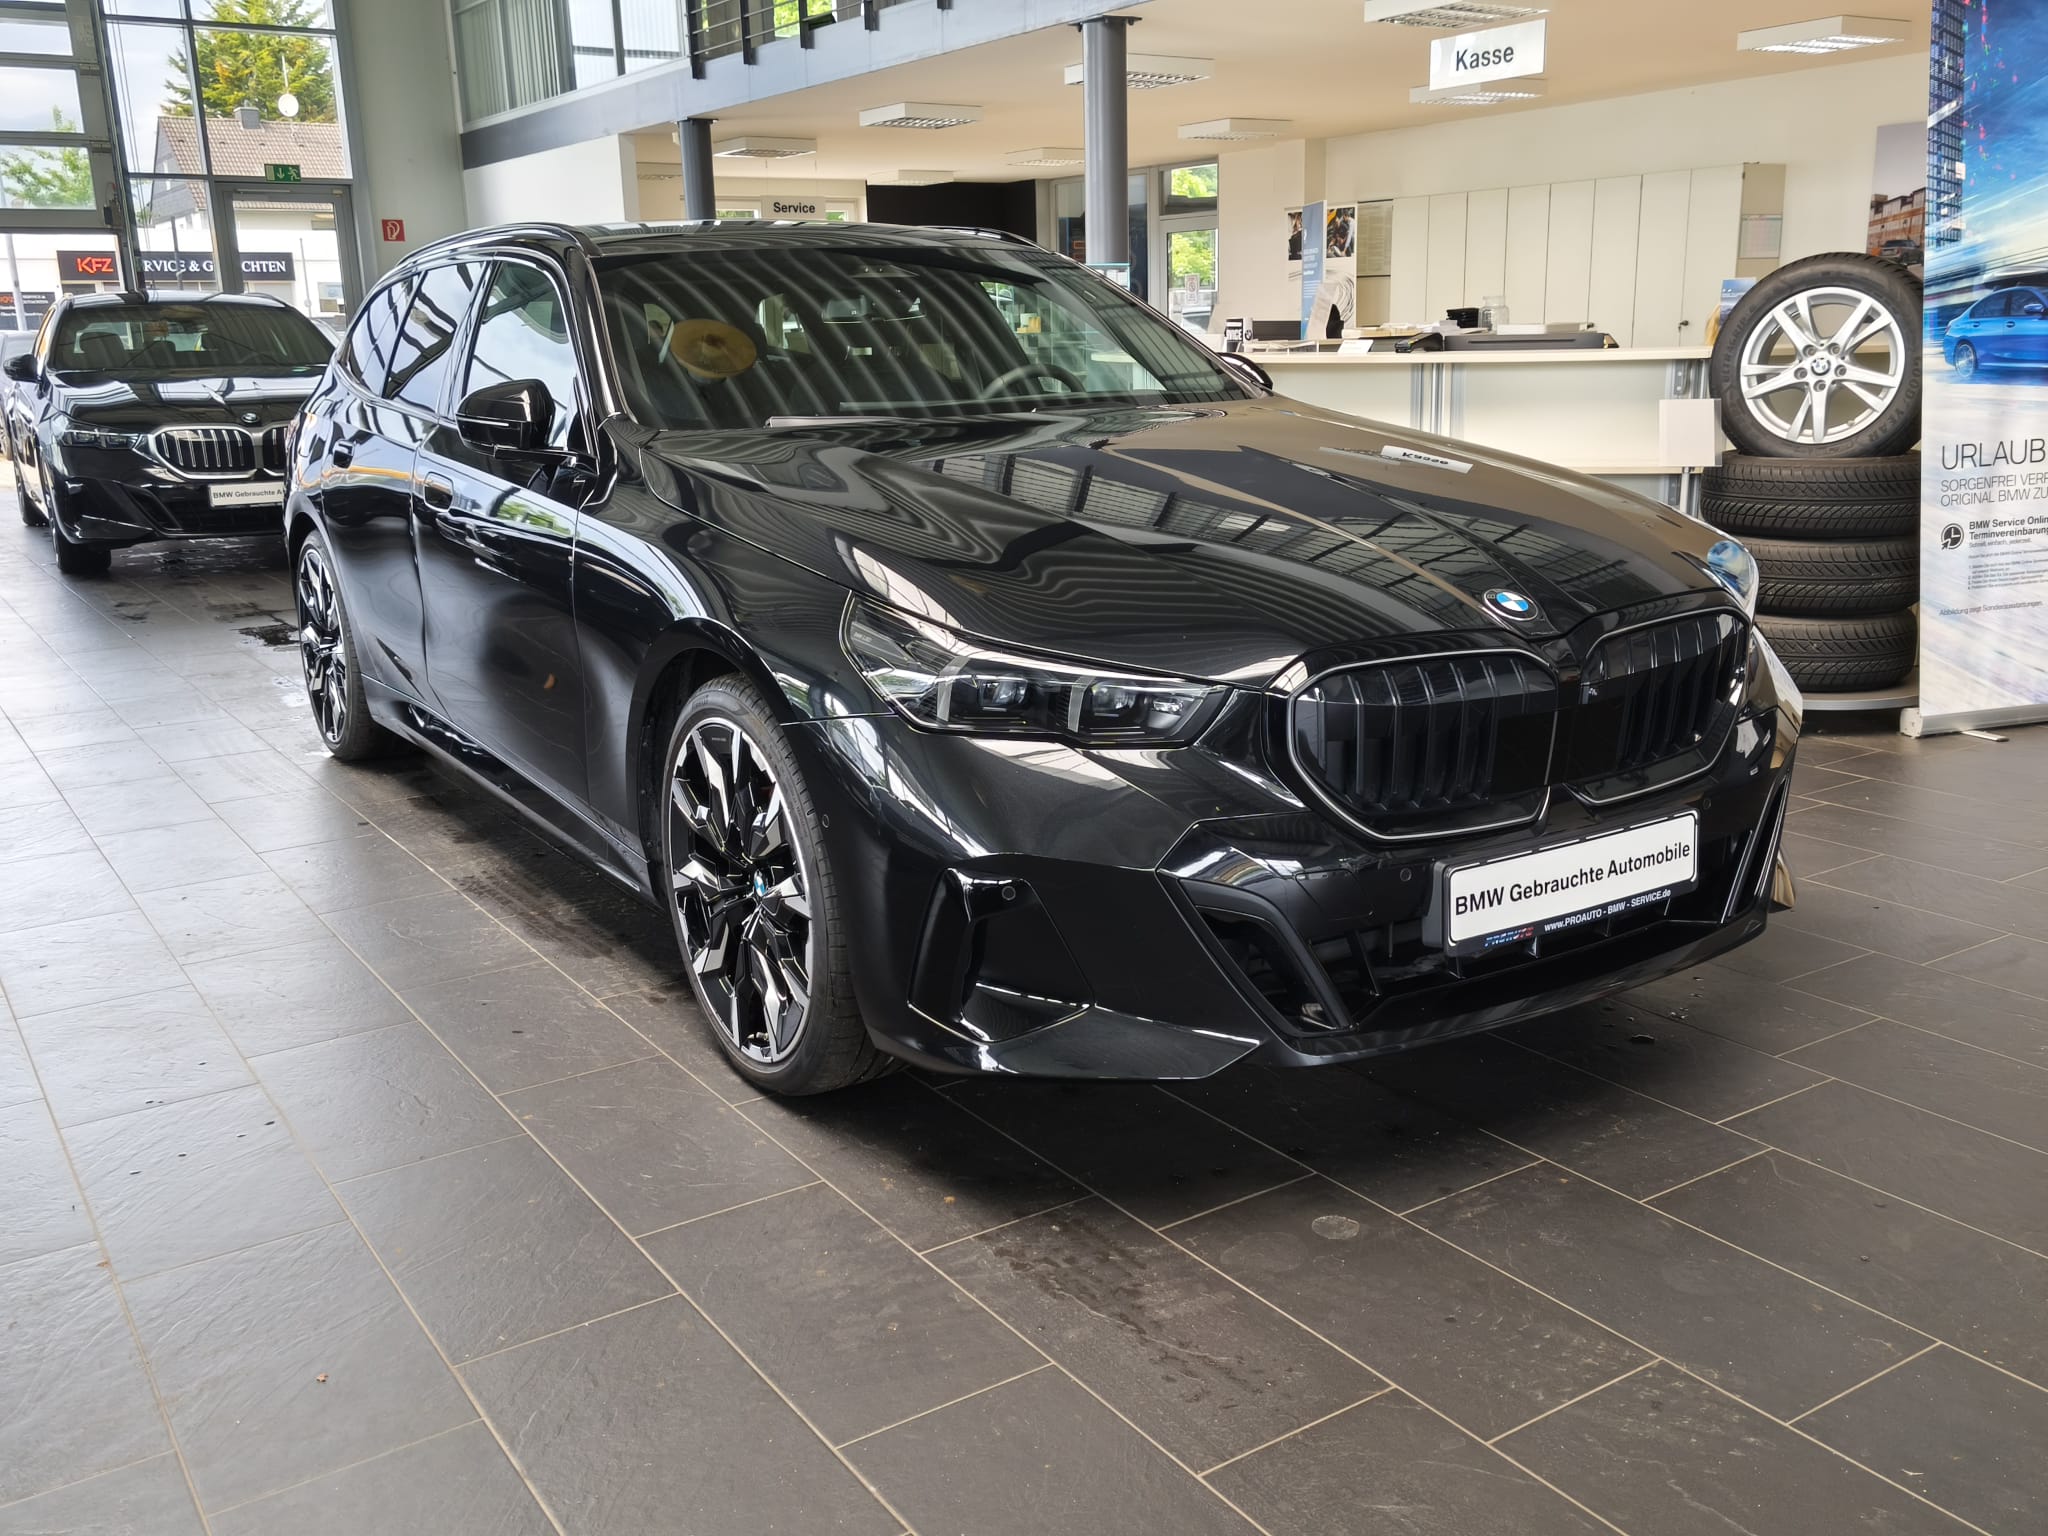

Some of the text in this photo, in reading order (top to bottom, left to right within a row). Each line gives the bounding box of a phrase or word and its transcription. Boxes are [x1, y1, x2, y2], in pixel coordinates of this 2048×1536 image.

[1456, 46, 1514, 71] Kasse
[773, 201, 816, 214] Service
[77, 256, 114, 274] KFZ
[144, 260, 186, 273] RVICE
[188, 260, 201, 273] &
[1941, 438, 2046, 471] URLAUB
[1940, 474, 2017, 493] SORGENFREI
[213, 491, 233, 499] BMW
[235, 489, 275, 498] Gebrauchte
[1940, 490, 1995, 507] ORIGINAL
[1998, 488, 2030, 502] BMW
[1969, 520, 1990, 530] BMW
[1992, 518, 2025, 528] Service
[1455, 841, 1691, 916] BMW Gebrauchte Automobile
[1543, 909, 1602, 932] www.PROAUTO
[1607, 901, 1626, 916] BMW
[1631, 888, 1672, 908] SERVICE.de
